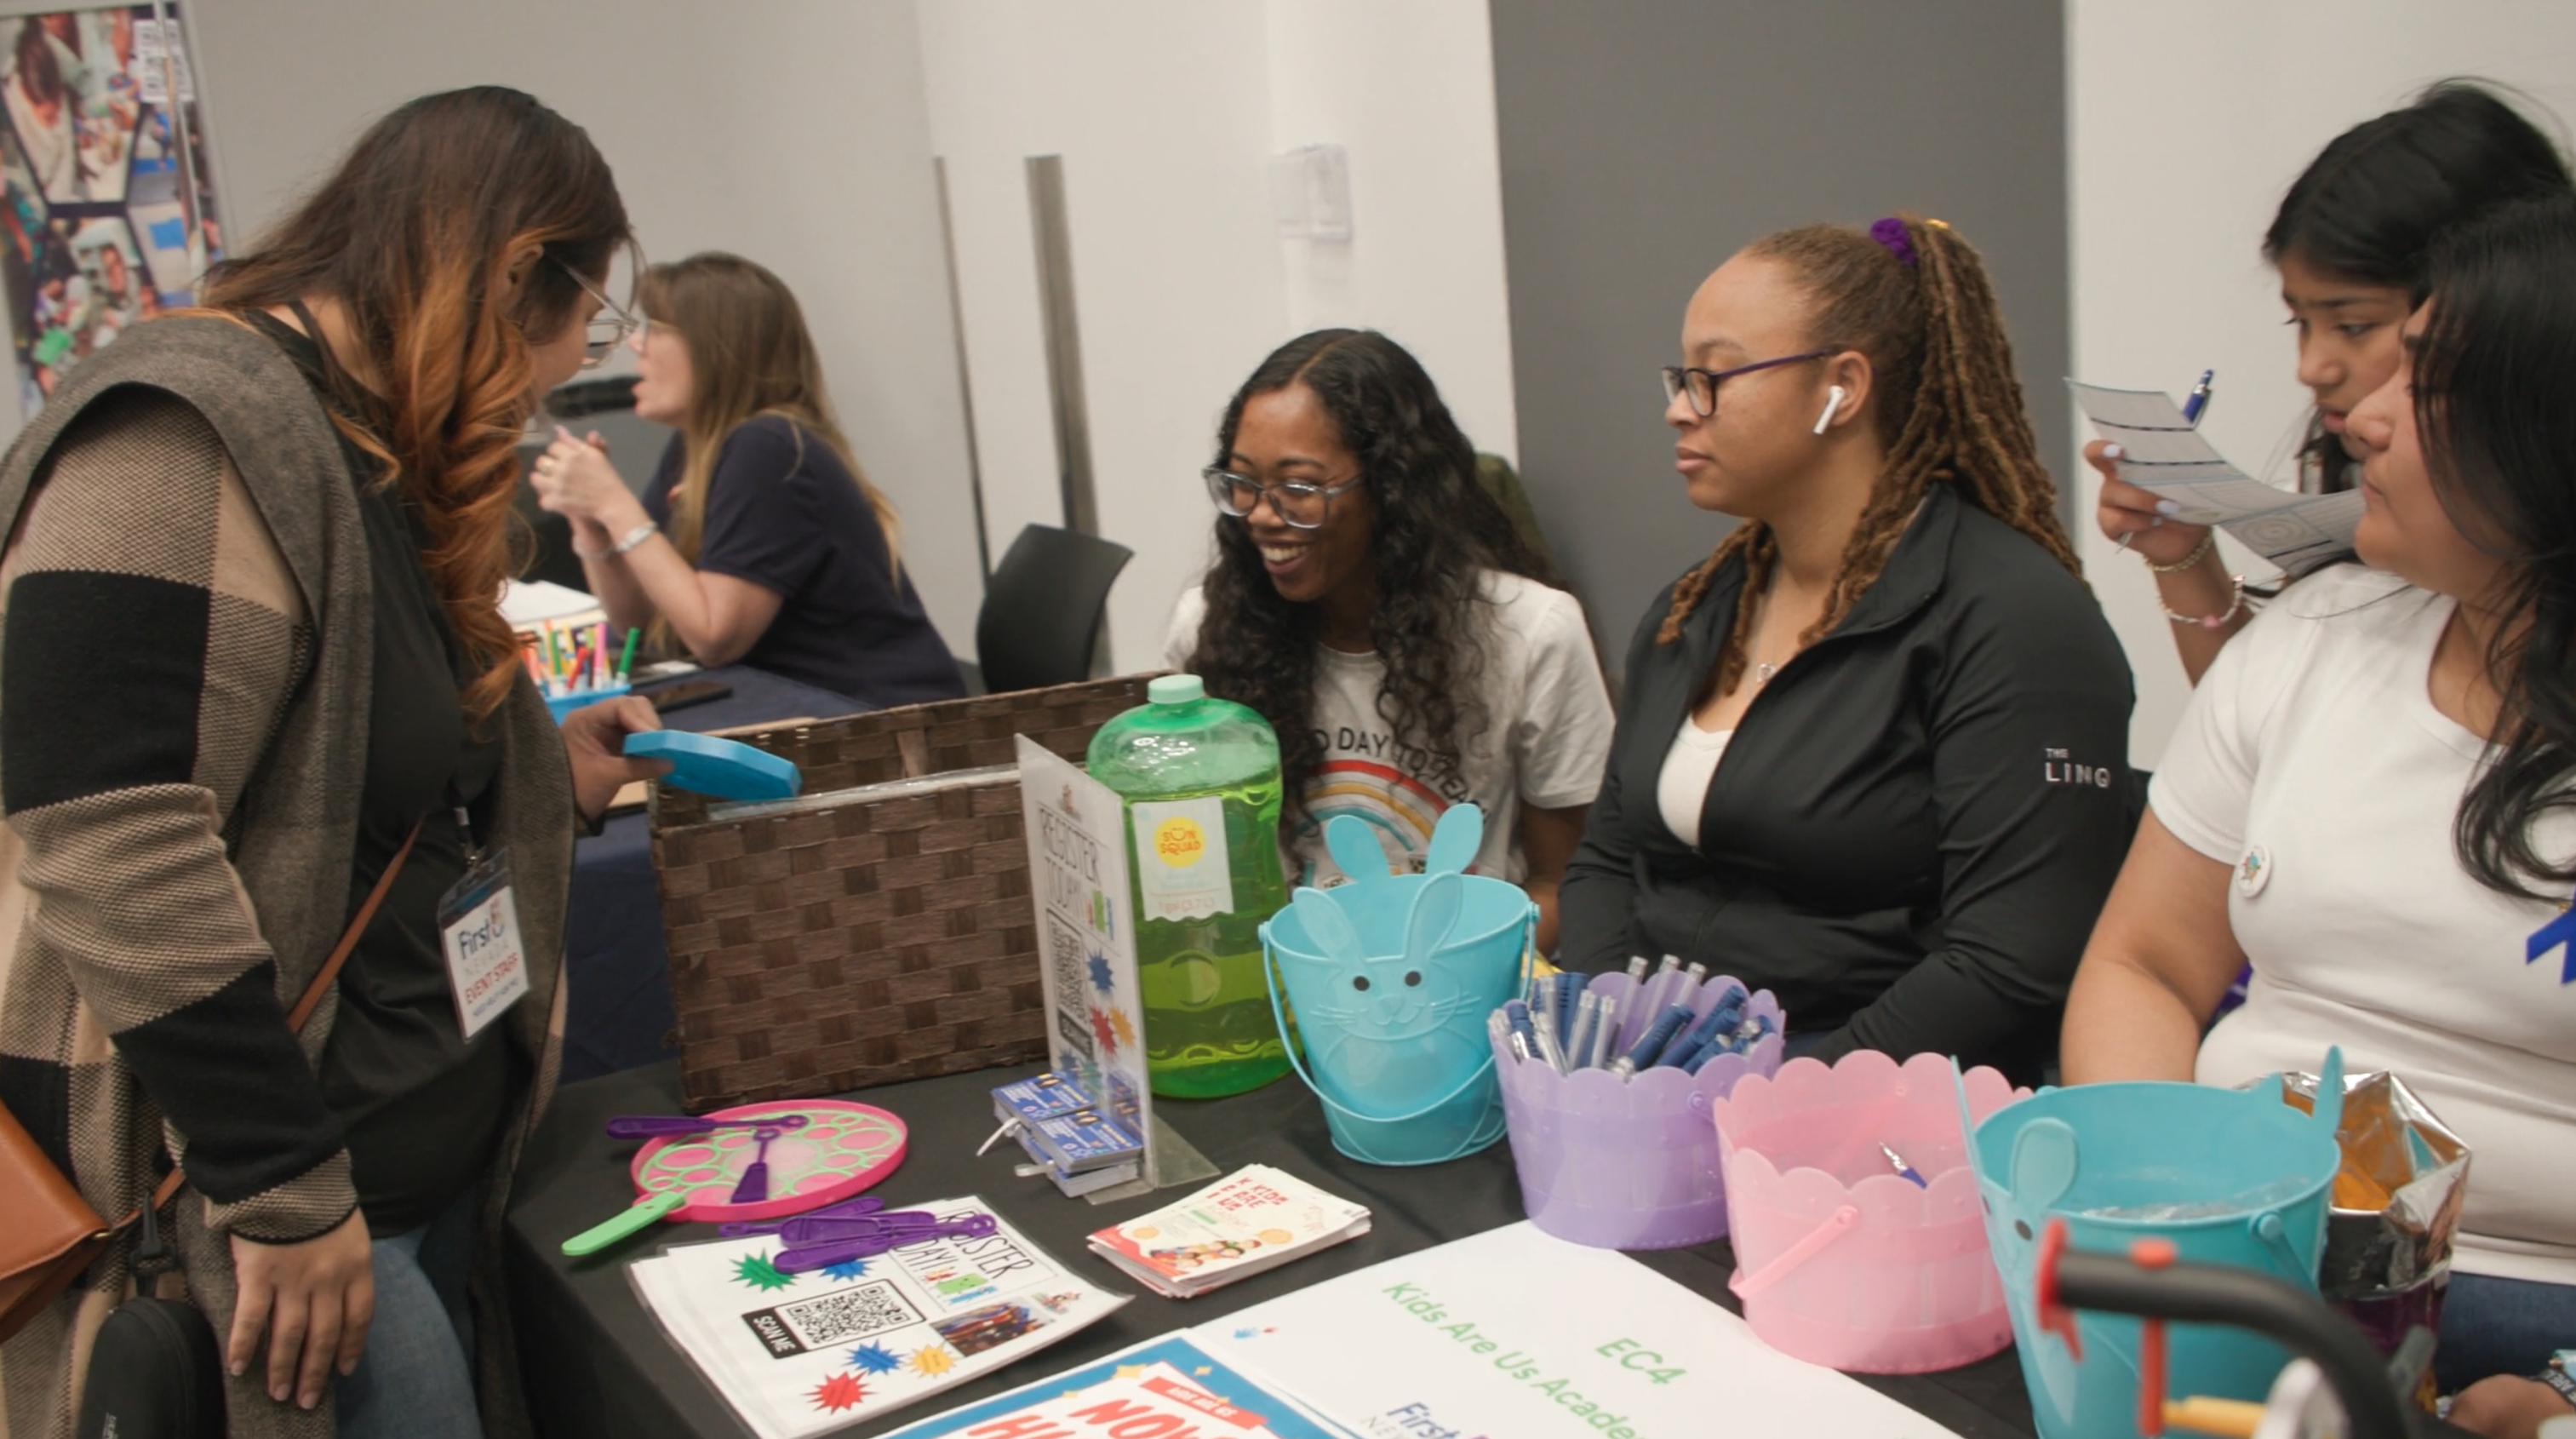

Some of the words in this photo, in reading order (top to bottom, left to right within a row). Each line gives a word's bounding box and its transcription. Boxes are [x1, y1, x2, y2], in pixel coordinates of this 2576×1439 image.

[1338, 727, 1390, 758] DAY
[2045, 748, 2069, 759] THE
[2045, 762, 2111, 788] LINQ
[1159, 840, 1202, 856] SQUAD
[753, 1316, 786, 1339] SCAN
[770, 1336, 797, 1352] ME
[1382, 1282, 1447, 1323] Kids
[1439, 1321, 1498, 1355] Are
[1494, 1351, 1539, 1381] Us
[1595, 1338, 1686, 1385] EC4
